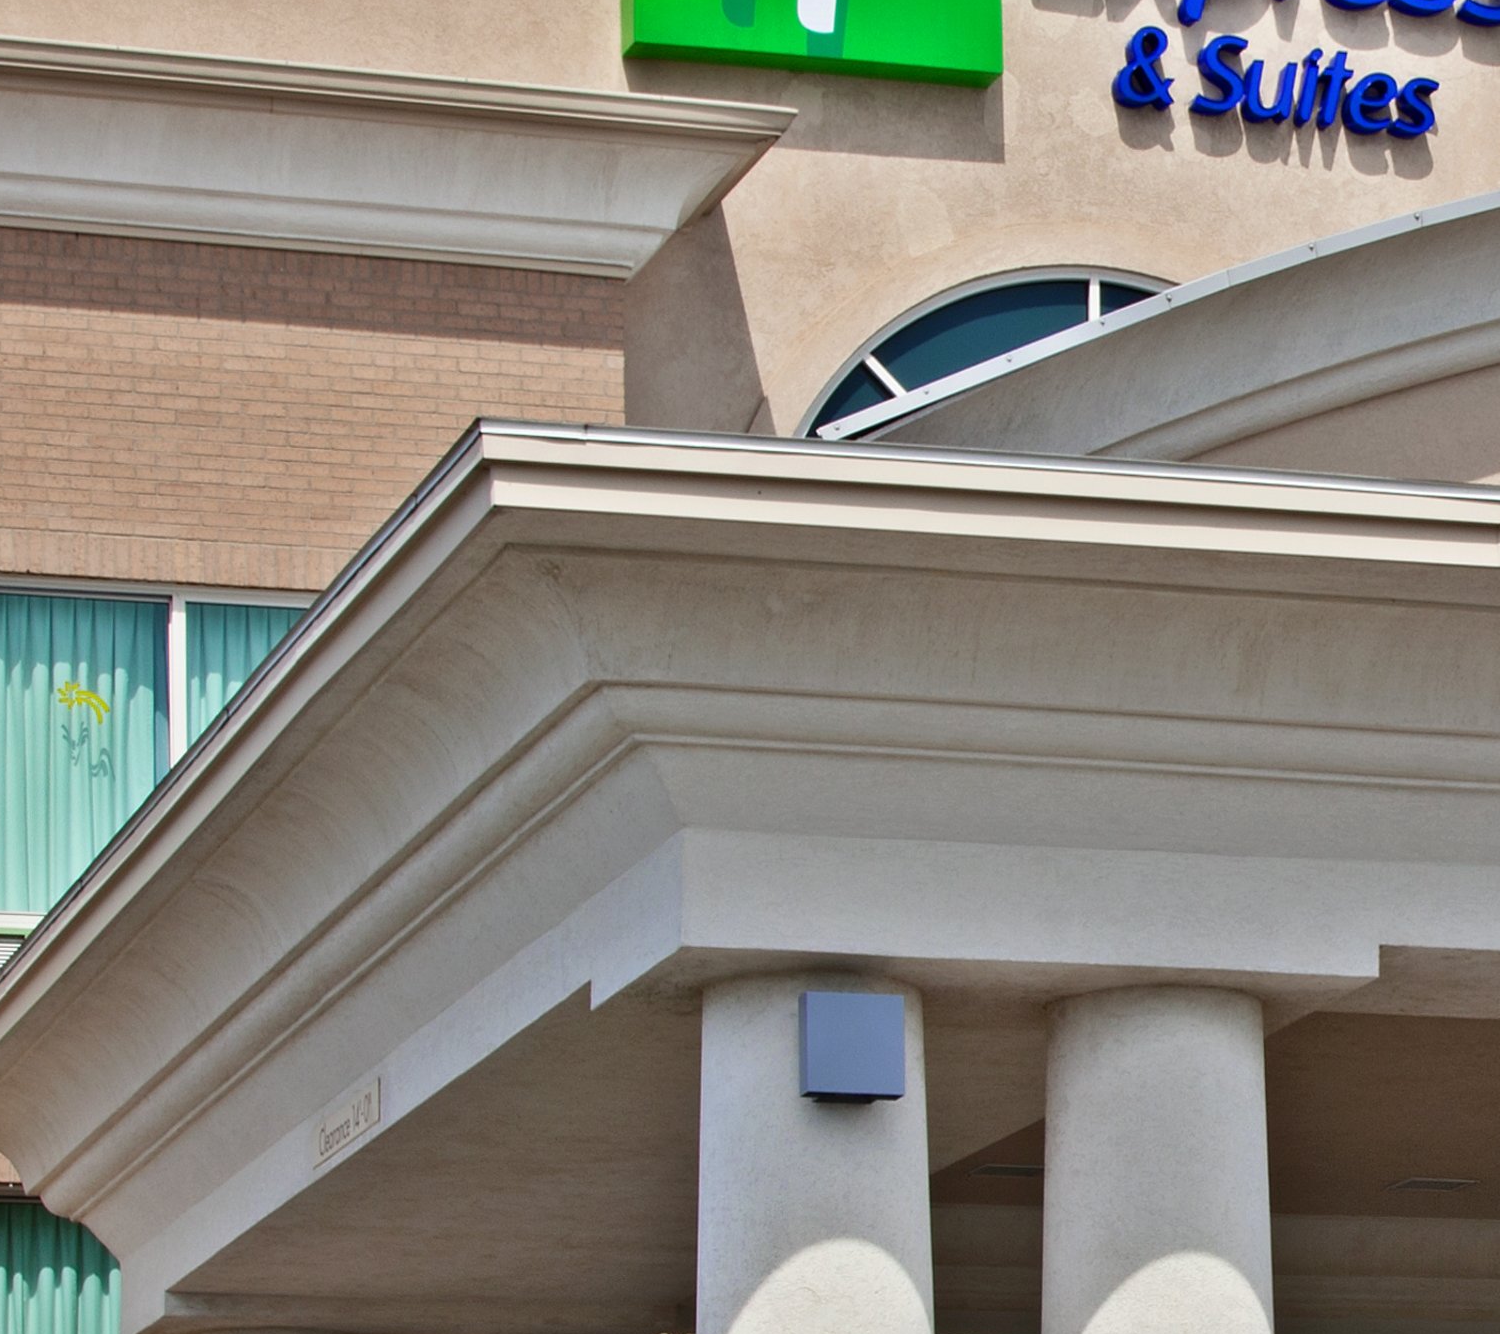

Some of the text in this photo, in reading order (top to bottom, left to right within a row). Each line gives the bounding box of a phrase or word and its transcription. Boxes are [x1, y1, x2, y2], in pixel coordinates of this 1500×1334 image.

[1113, 26, 1440, 139] & Suites
[319, 1118, 350, 1157] Clearance
